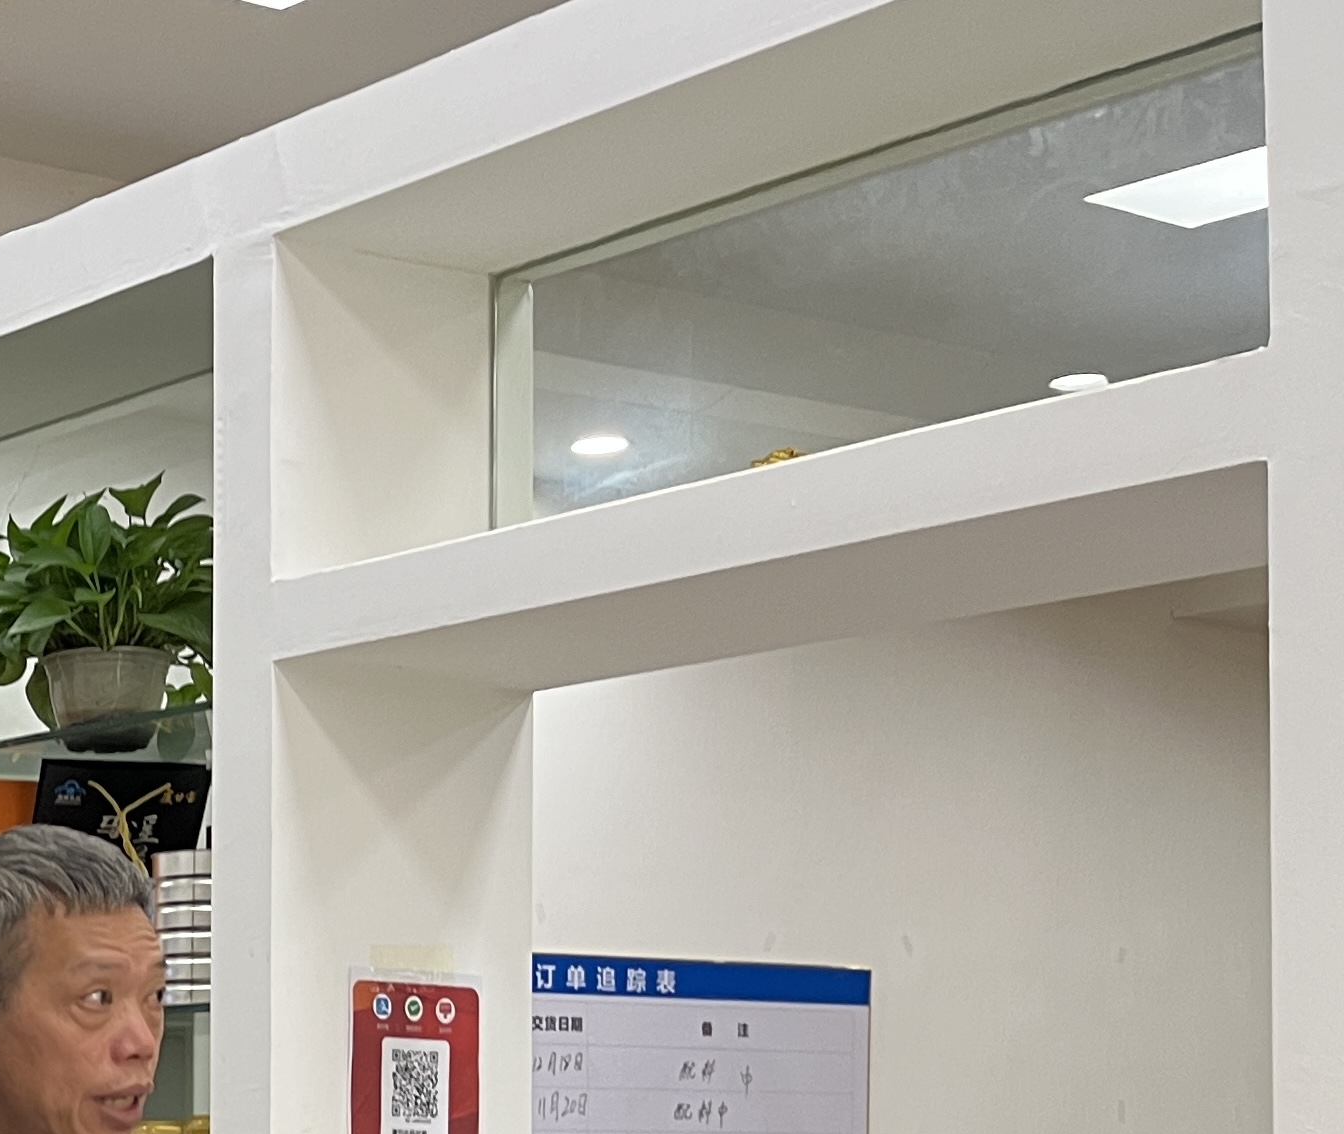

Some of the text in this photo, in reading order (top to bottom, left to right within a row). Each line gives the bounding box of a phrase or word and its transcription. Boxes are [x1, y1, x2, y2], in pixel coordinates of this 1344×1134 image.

[535, 963, 677, 994] 订单追踪表
[532, 1015, 584, 1033] 交货日期
